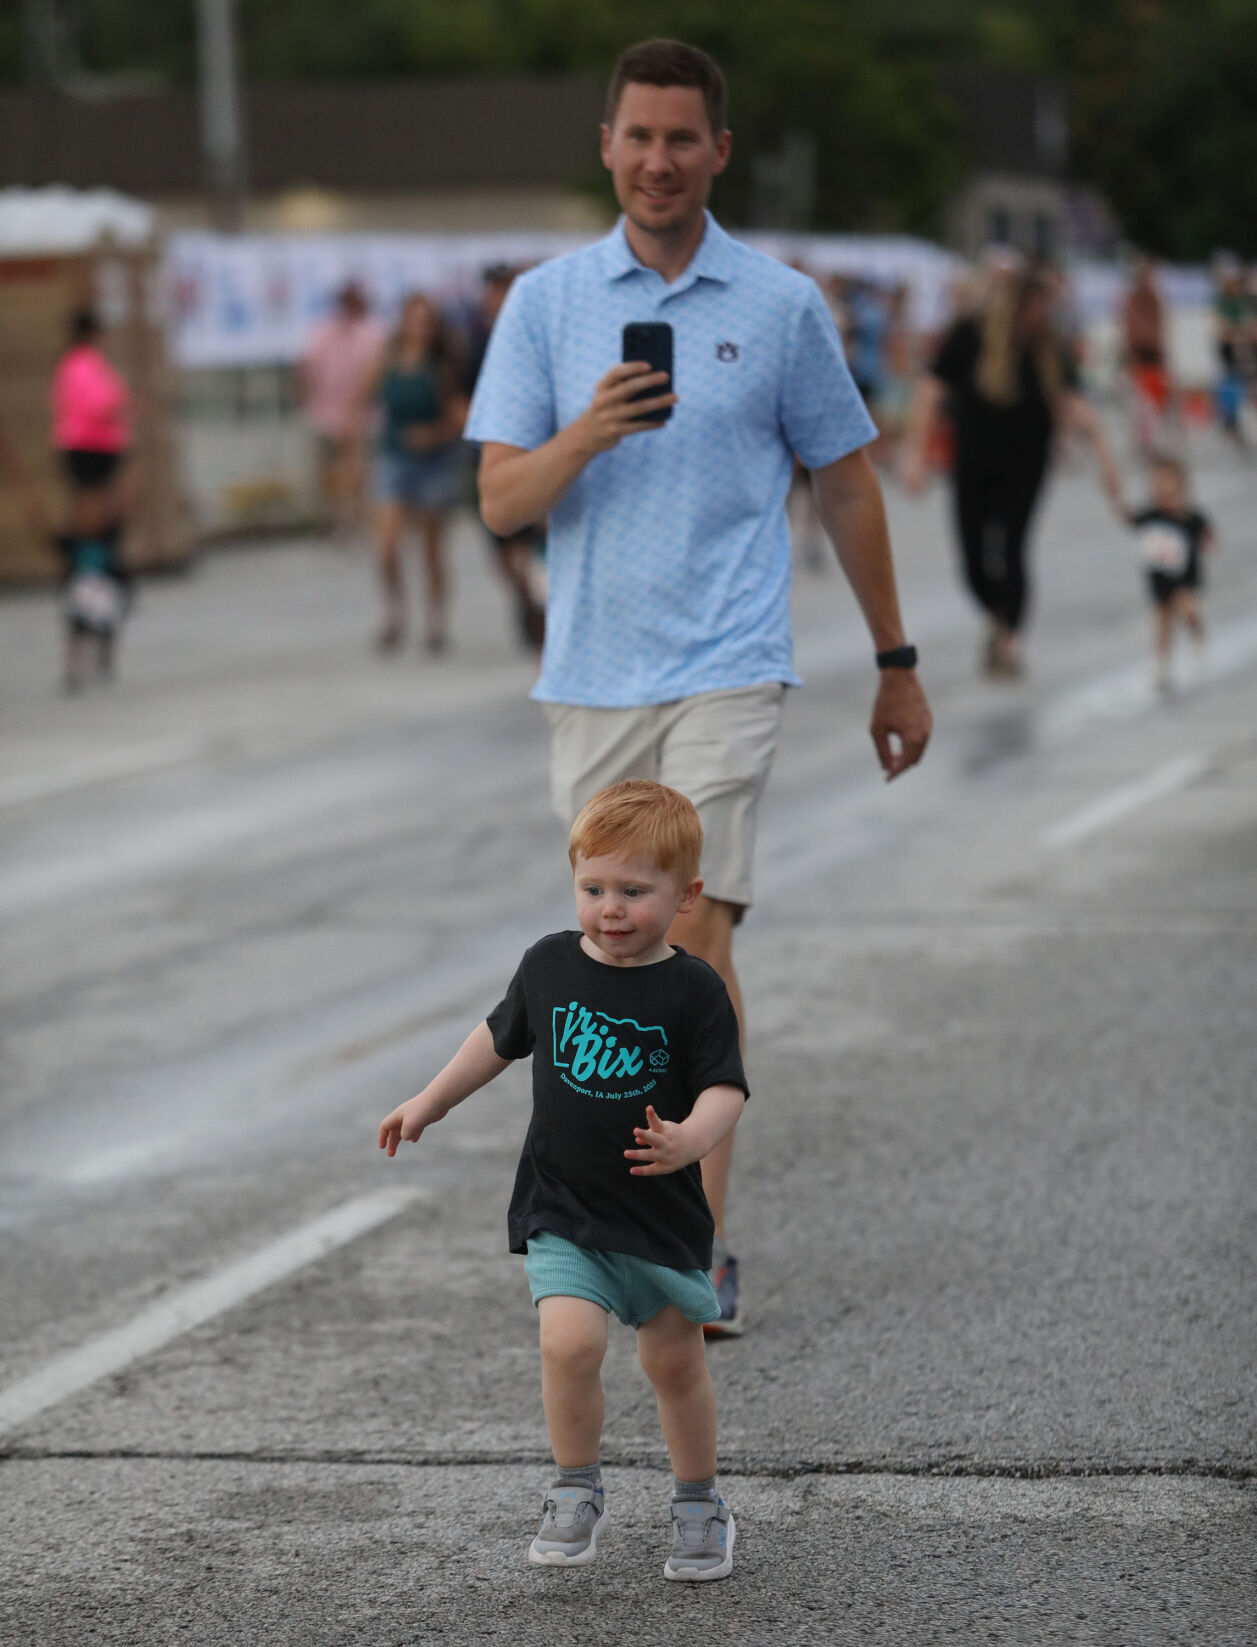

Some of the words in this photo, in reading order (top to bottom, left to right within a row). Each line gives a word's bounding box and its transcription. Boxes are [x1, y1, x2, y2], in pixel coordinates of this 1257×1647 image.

[571, 1035, 644, 1082] Bix
[560, 1072, 593, 1098] Davenport,
[595, 1090, 604, 1099] IA
[605, 1091, 622, 1101] July
